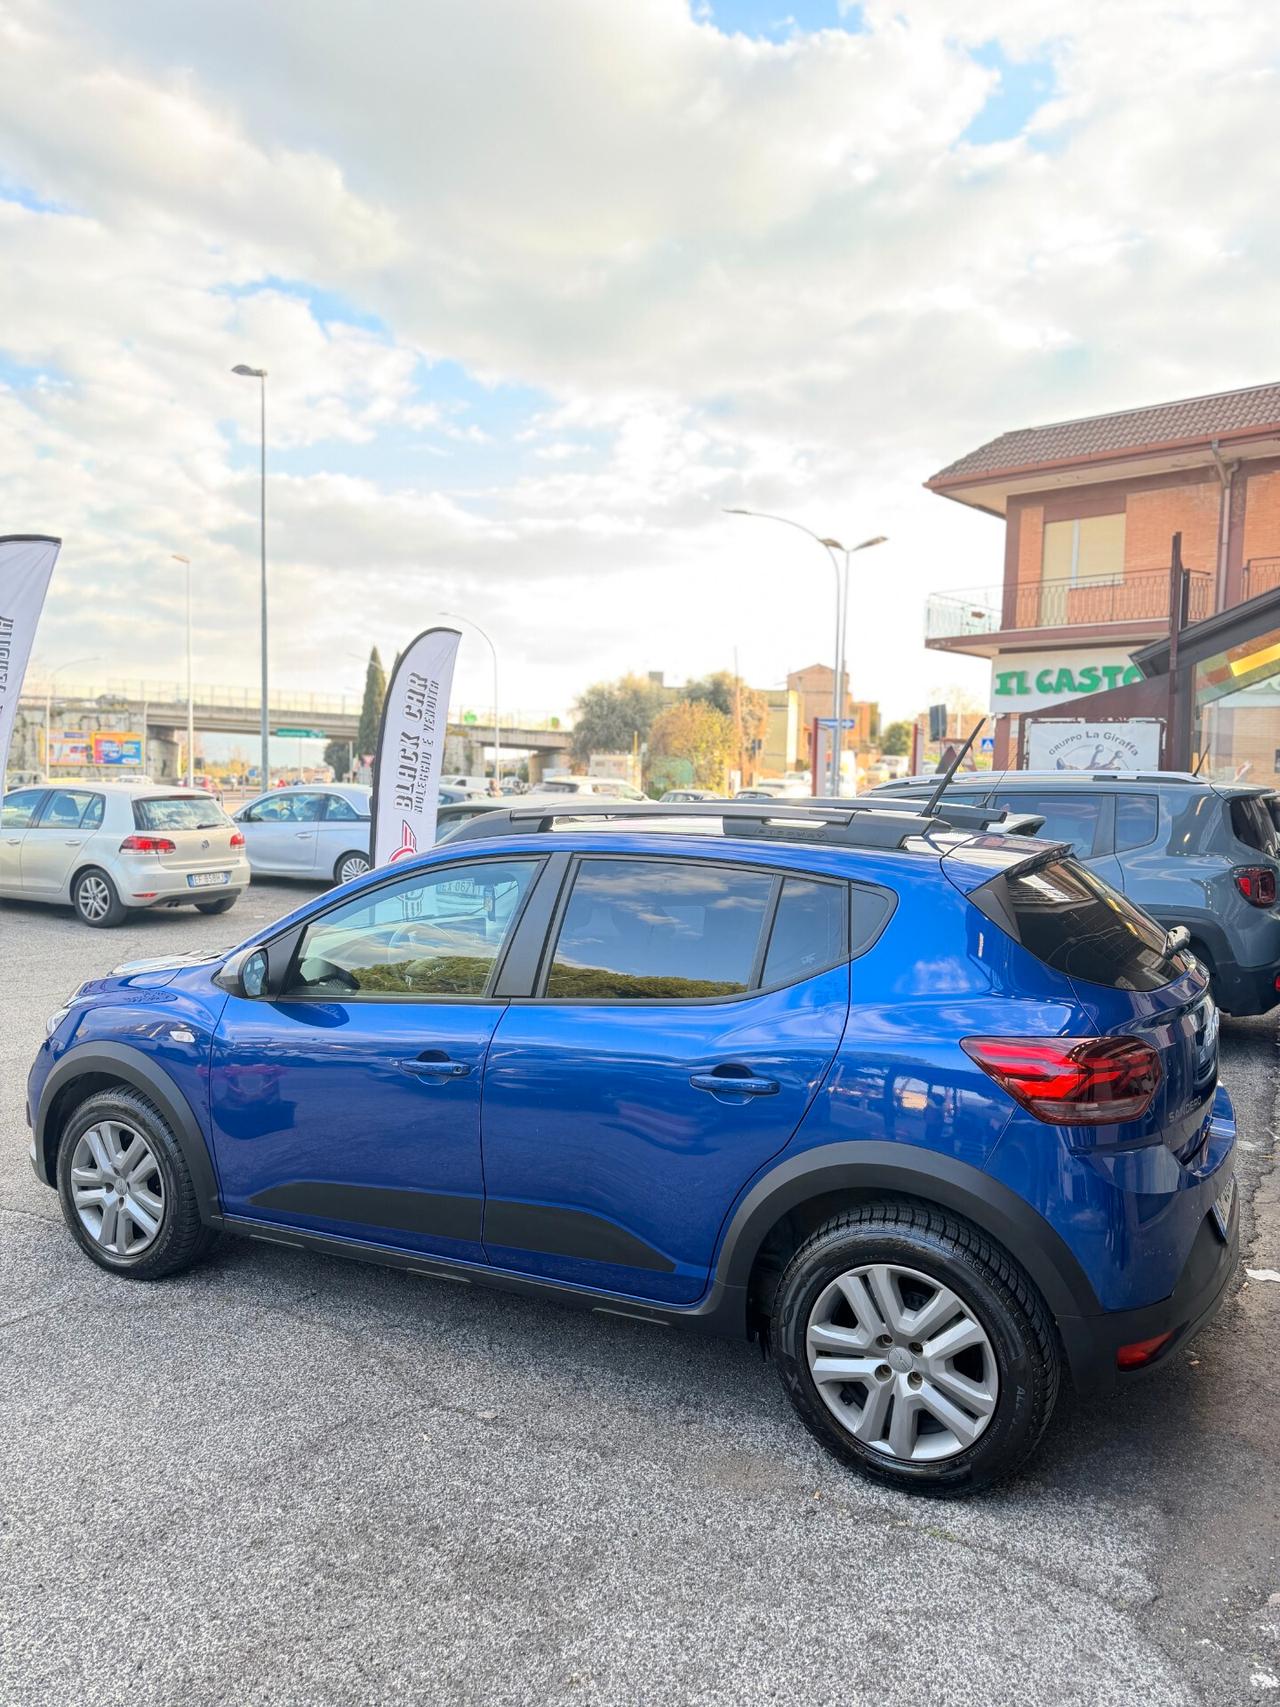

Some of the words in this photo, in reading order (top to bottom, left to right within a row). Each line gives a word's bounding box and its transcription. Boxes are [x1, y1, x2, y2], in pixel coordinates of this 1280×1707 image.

[403, 672, 428, 722] CAR
[423, 680, 440, 732] VENDITA
[422, 737, 434, 747] E
[1048, 733, 1083, 756] GRUPPO
[1085, 731, 1100, 739] La
[1103, 731, 1139, 757] Giraffa
[394, 731, 420, 811] BLACK
[414, 753, 433, 814] NOLEGGIO
[1168, 1095, 1202, 1123] SANDERO
